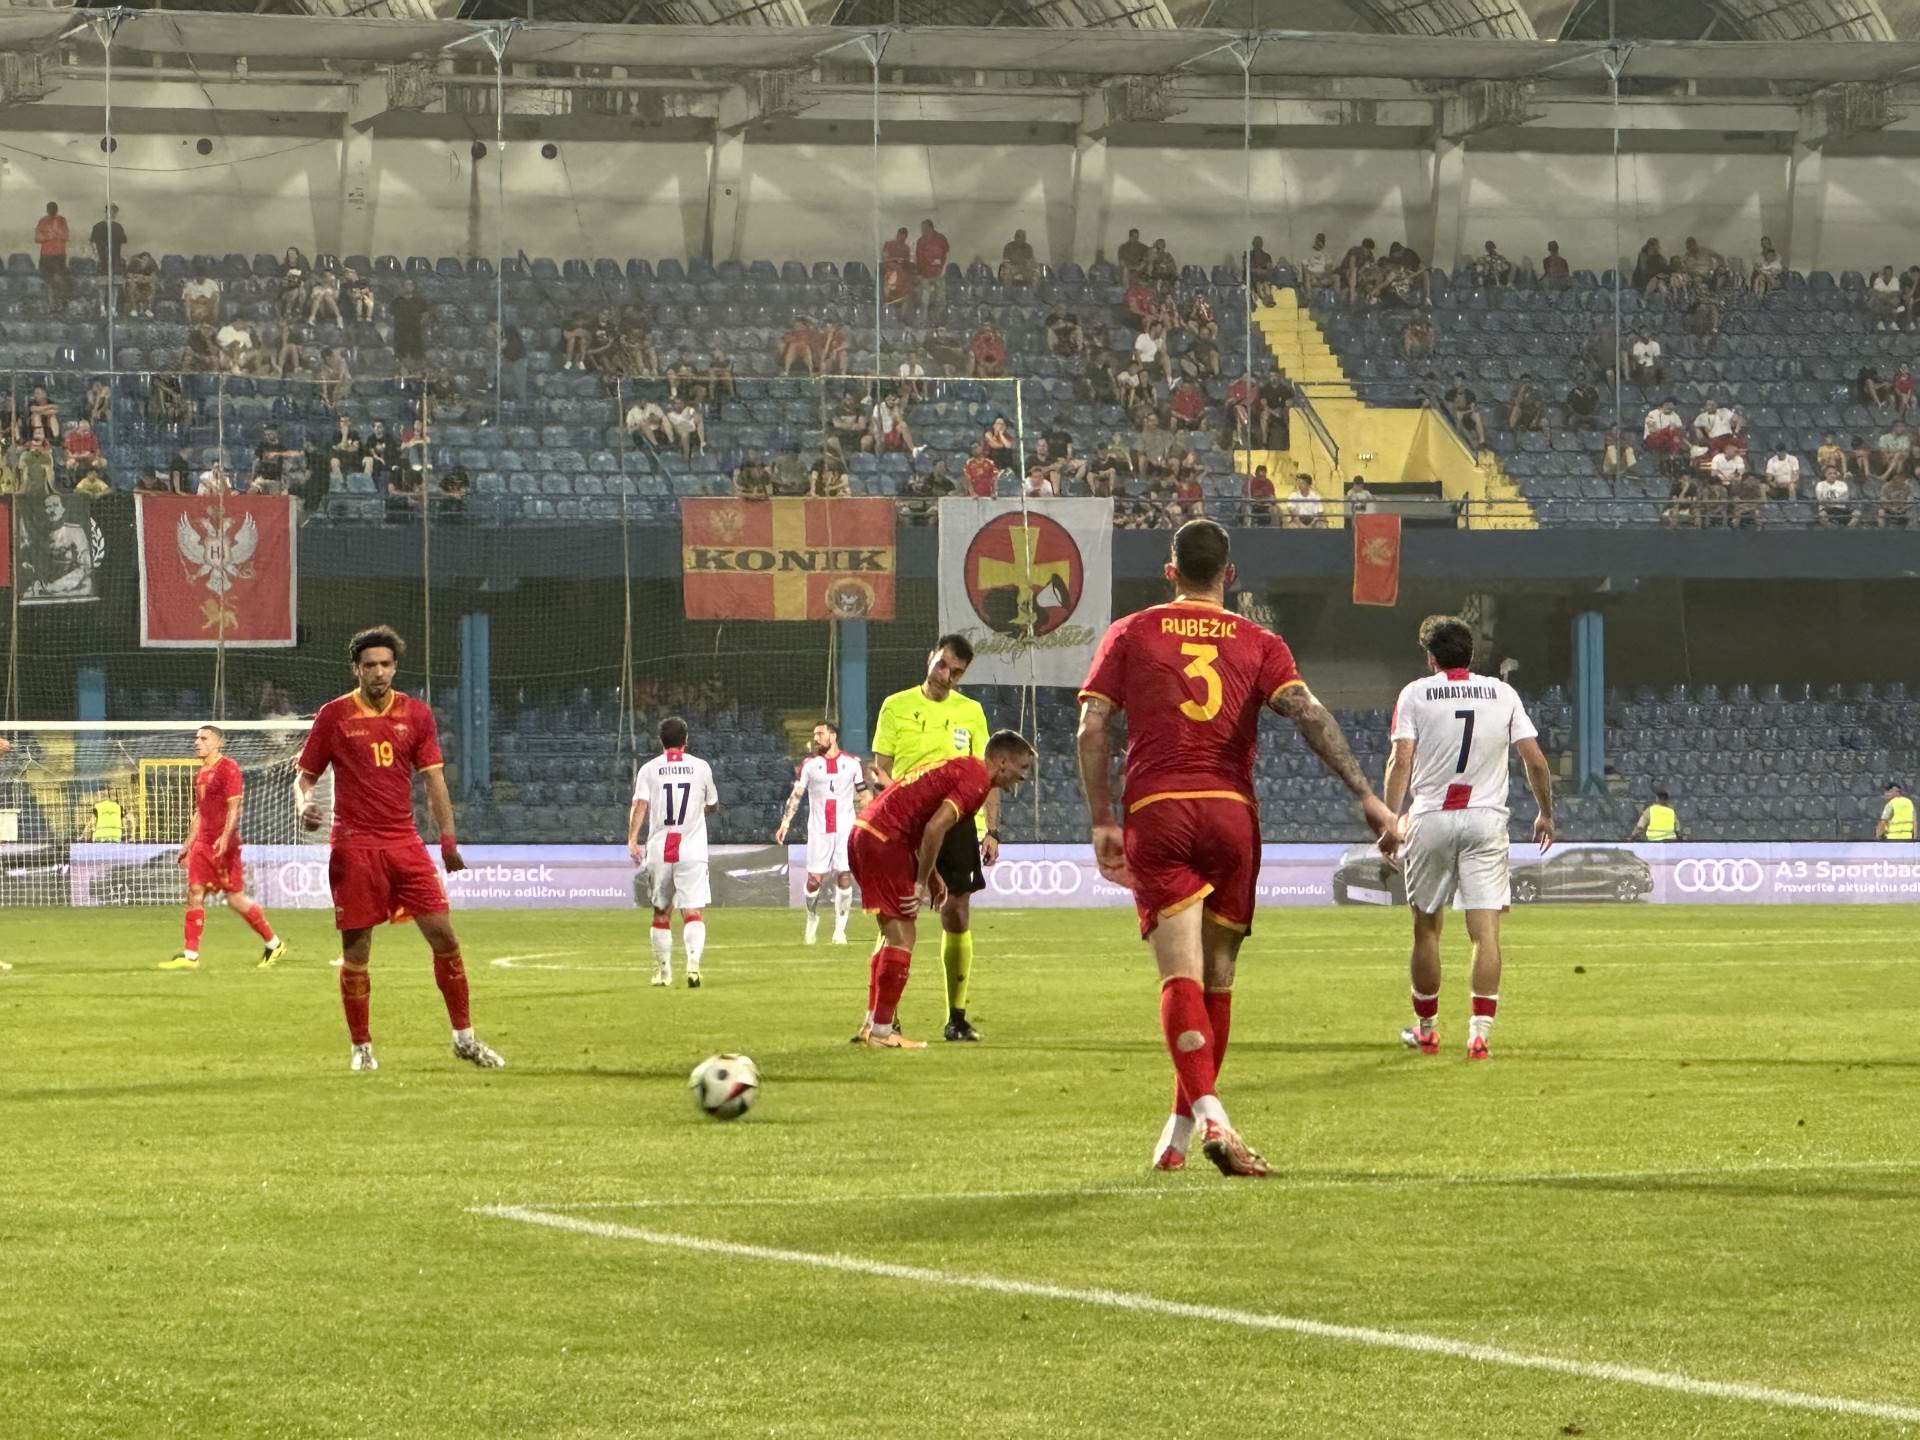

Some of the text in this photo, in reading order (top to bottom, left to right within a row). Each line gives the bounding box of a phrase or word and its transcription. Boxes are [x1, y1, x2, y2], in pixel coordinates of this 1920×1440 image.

[689, 549, 887, 572] KONIK
[1161, 617, 1237, 639] RUBEŽIĆ
[1180, 642, 1223, 721] 3
[1454, 709, 1475, 774] 7
[370, 740, 394, 767] 19
[663, 782, 691, 826] 17
[438, 863, 554, 885] portback
[1775, 860, 1808, 879] A3
[450, 885, 627, 899] aktuelnu odličnu ponudu.
[1272, 884, 1326, 898] ponudu.
[1773, 882, 1835, 893] Proverite
[1838, 882, 1897, 893] aktuelnu
